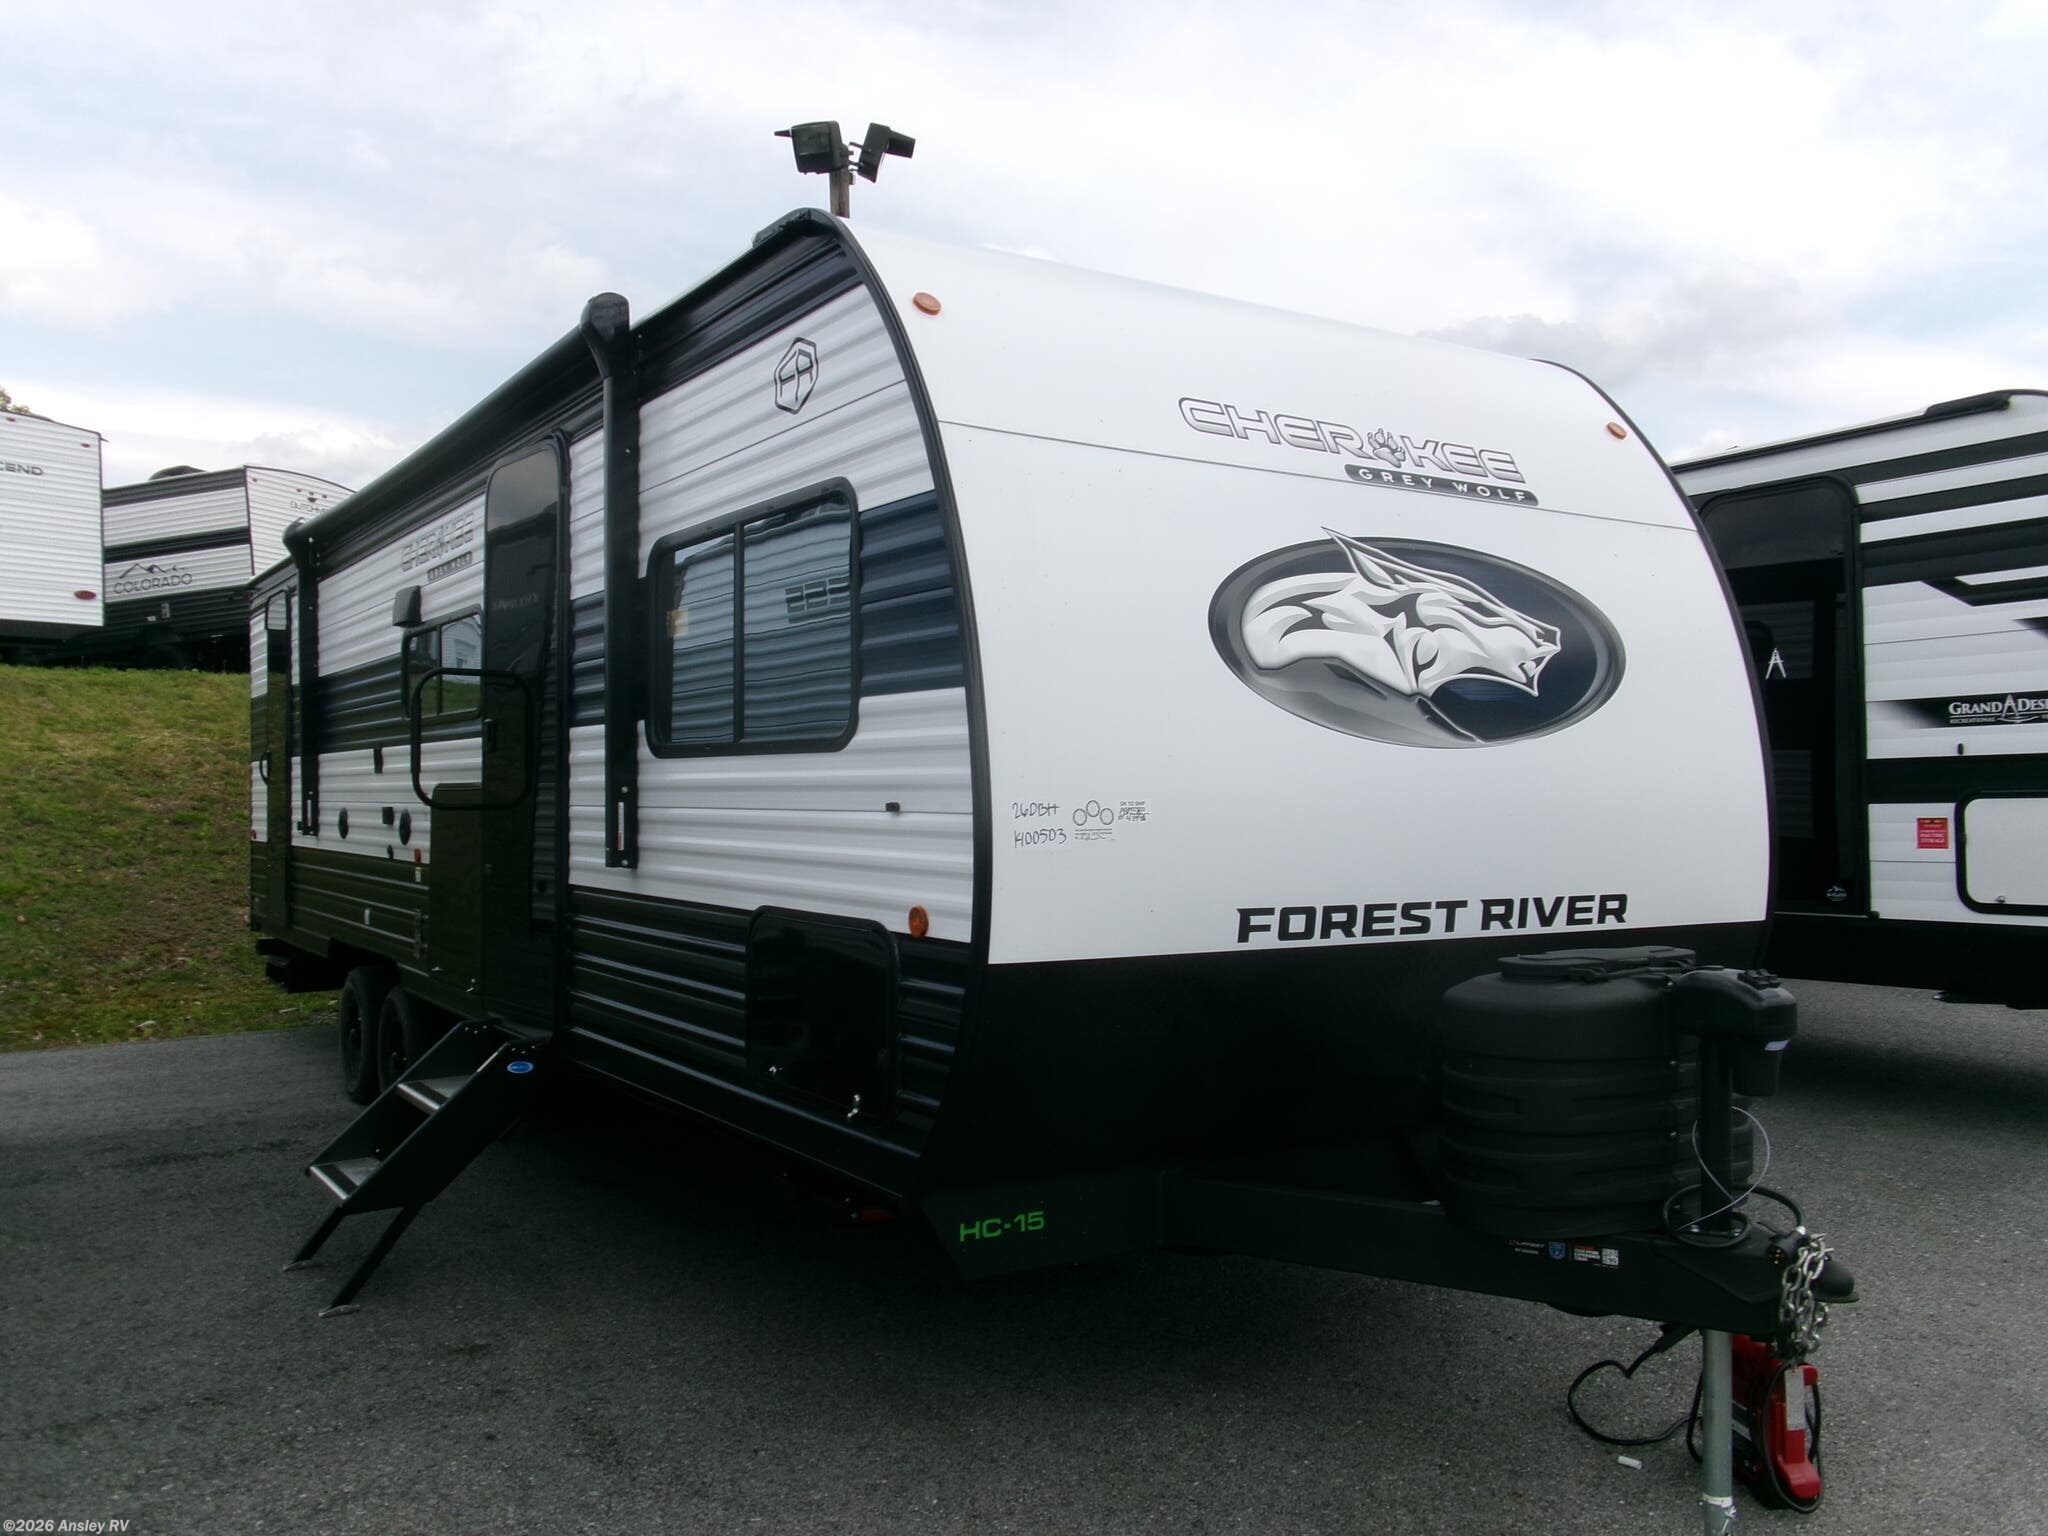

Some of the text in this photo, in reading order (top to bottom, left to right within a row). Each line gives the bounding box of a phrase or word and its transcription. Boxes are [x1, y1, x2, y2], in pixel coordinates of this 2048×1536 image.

[1358, 468, 1526, 502] GREY WOLF
[113, 573, 193, 594] COLORADO
[1948, 701, 2003, 715] GRAND
[1236, 893, 1629, 944] FOREST RIVER
[959, 1211, 1045, 1242] HC-15
